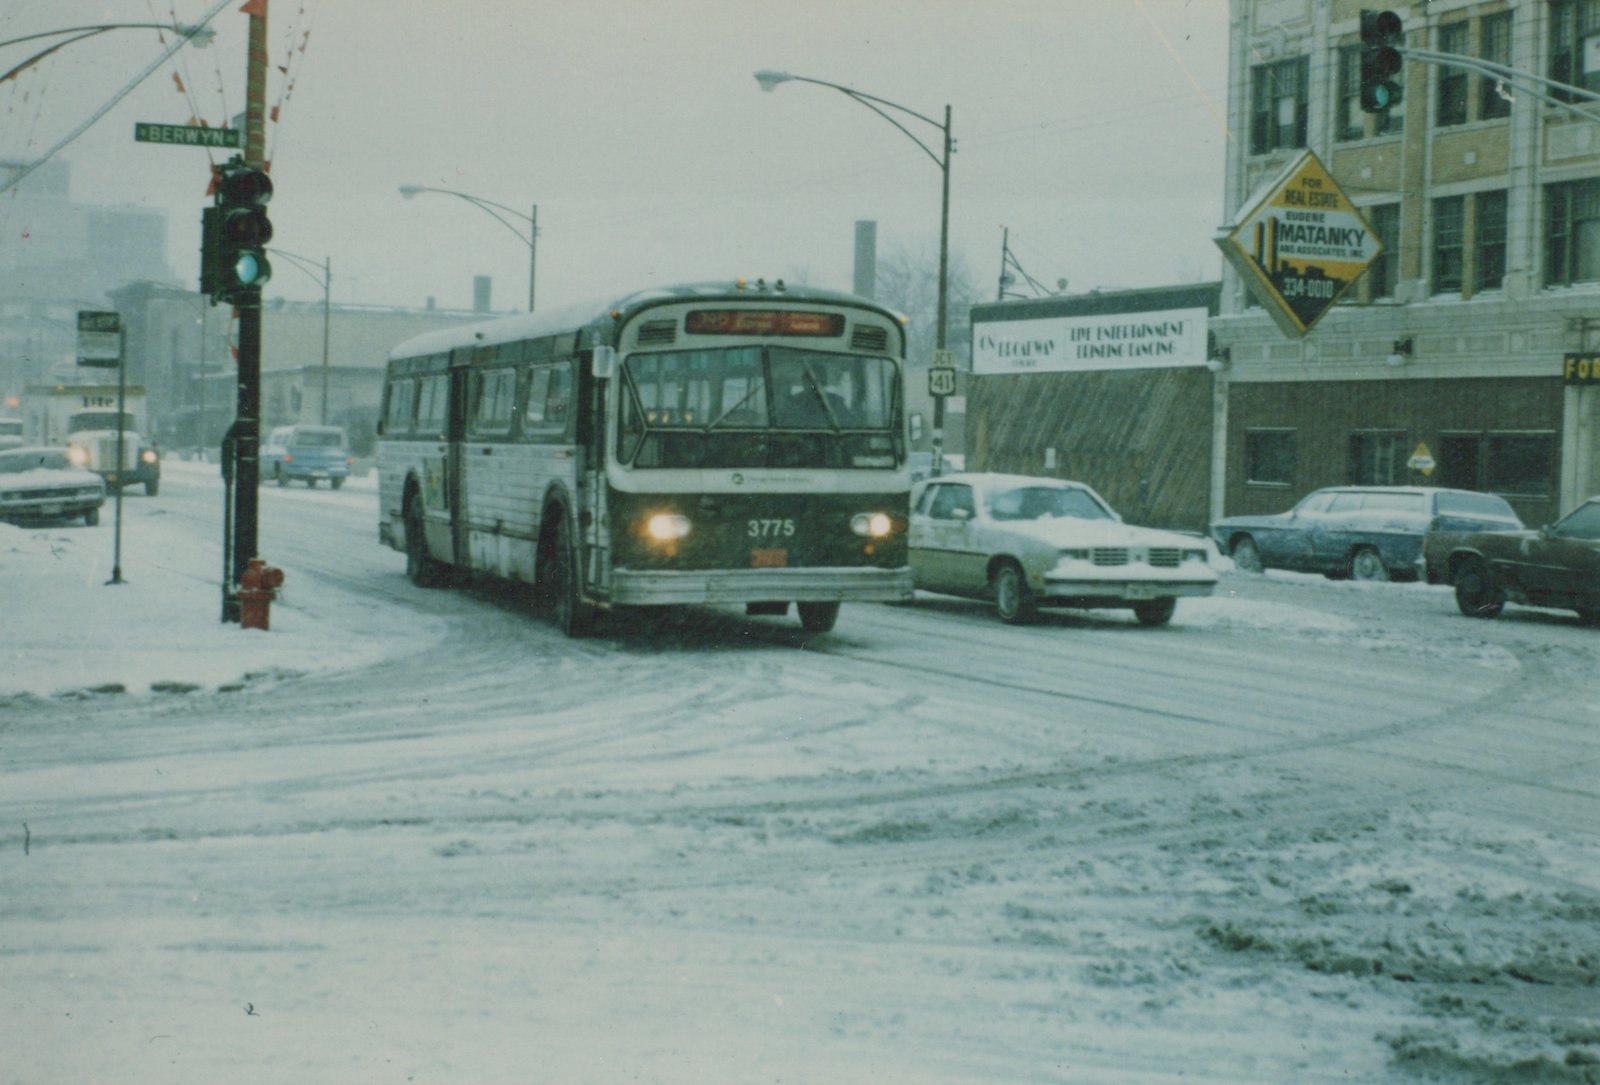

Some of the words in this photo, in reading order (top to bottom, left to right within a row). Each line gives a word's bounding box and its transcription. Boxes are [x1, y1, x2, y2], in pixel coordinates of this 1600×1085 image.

[148, 125, 225, 145] BERWYN
[1302, 178, 1322, 188] FOR
[1285, 189, 1306, 205] REAL
[1308, 191, 1338, 208] ESTATE
[1286, 211, 1325, 223] EUGENE
[1279, 223, 1365, 247] MATANKY
[1071, 326, 1091, 341] LIVE
[1096, 320, 1184, 341] ENTERTAINMENT
[933, 374, 951, 390] 41
[748, 519, 796, 537] 3775
